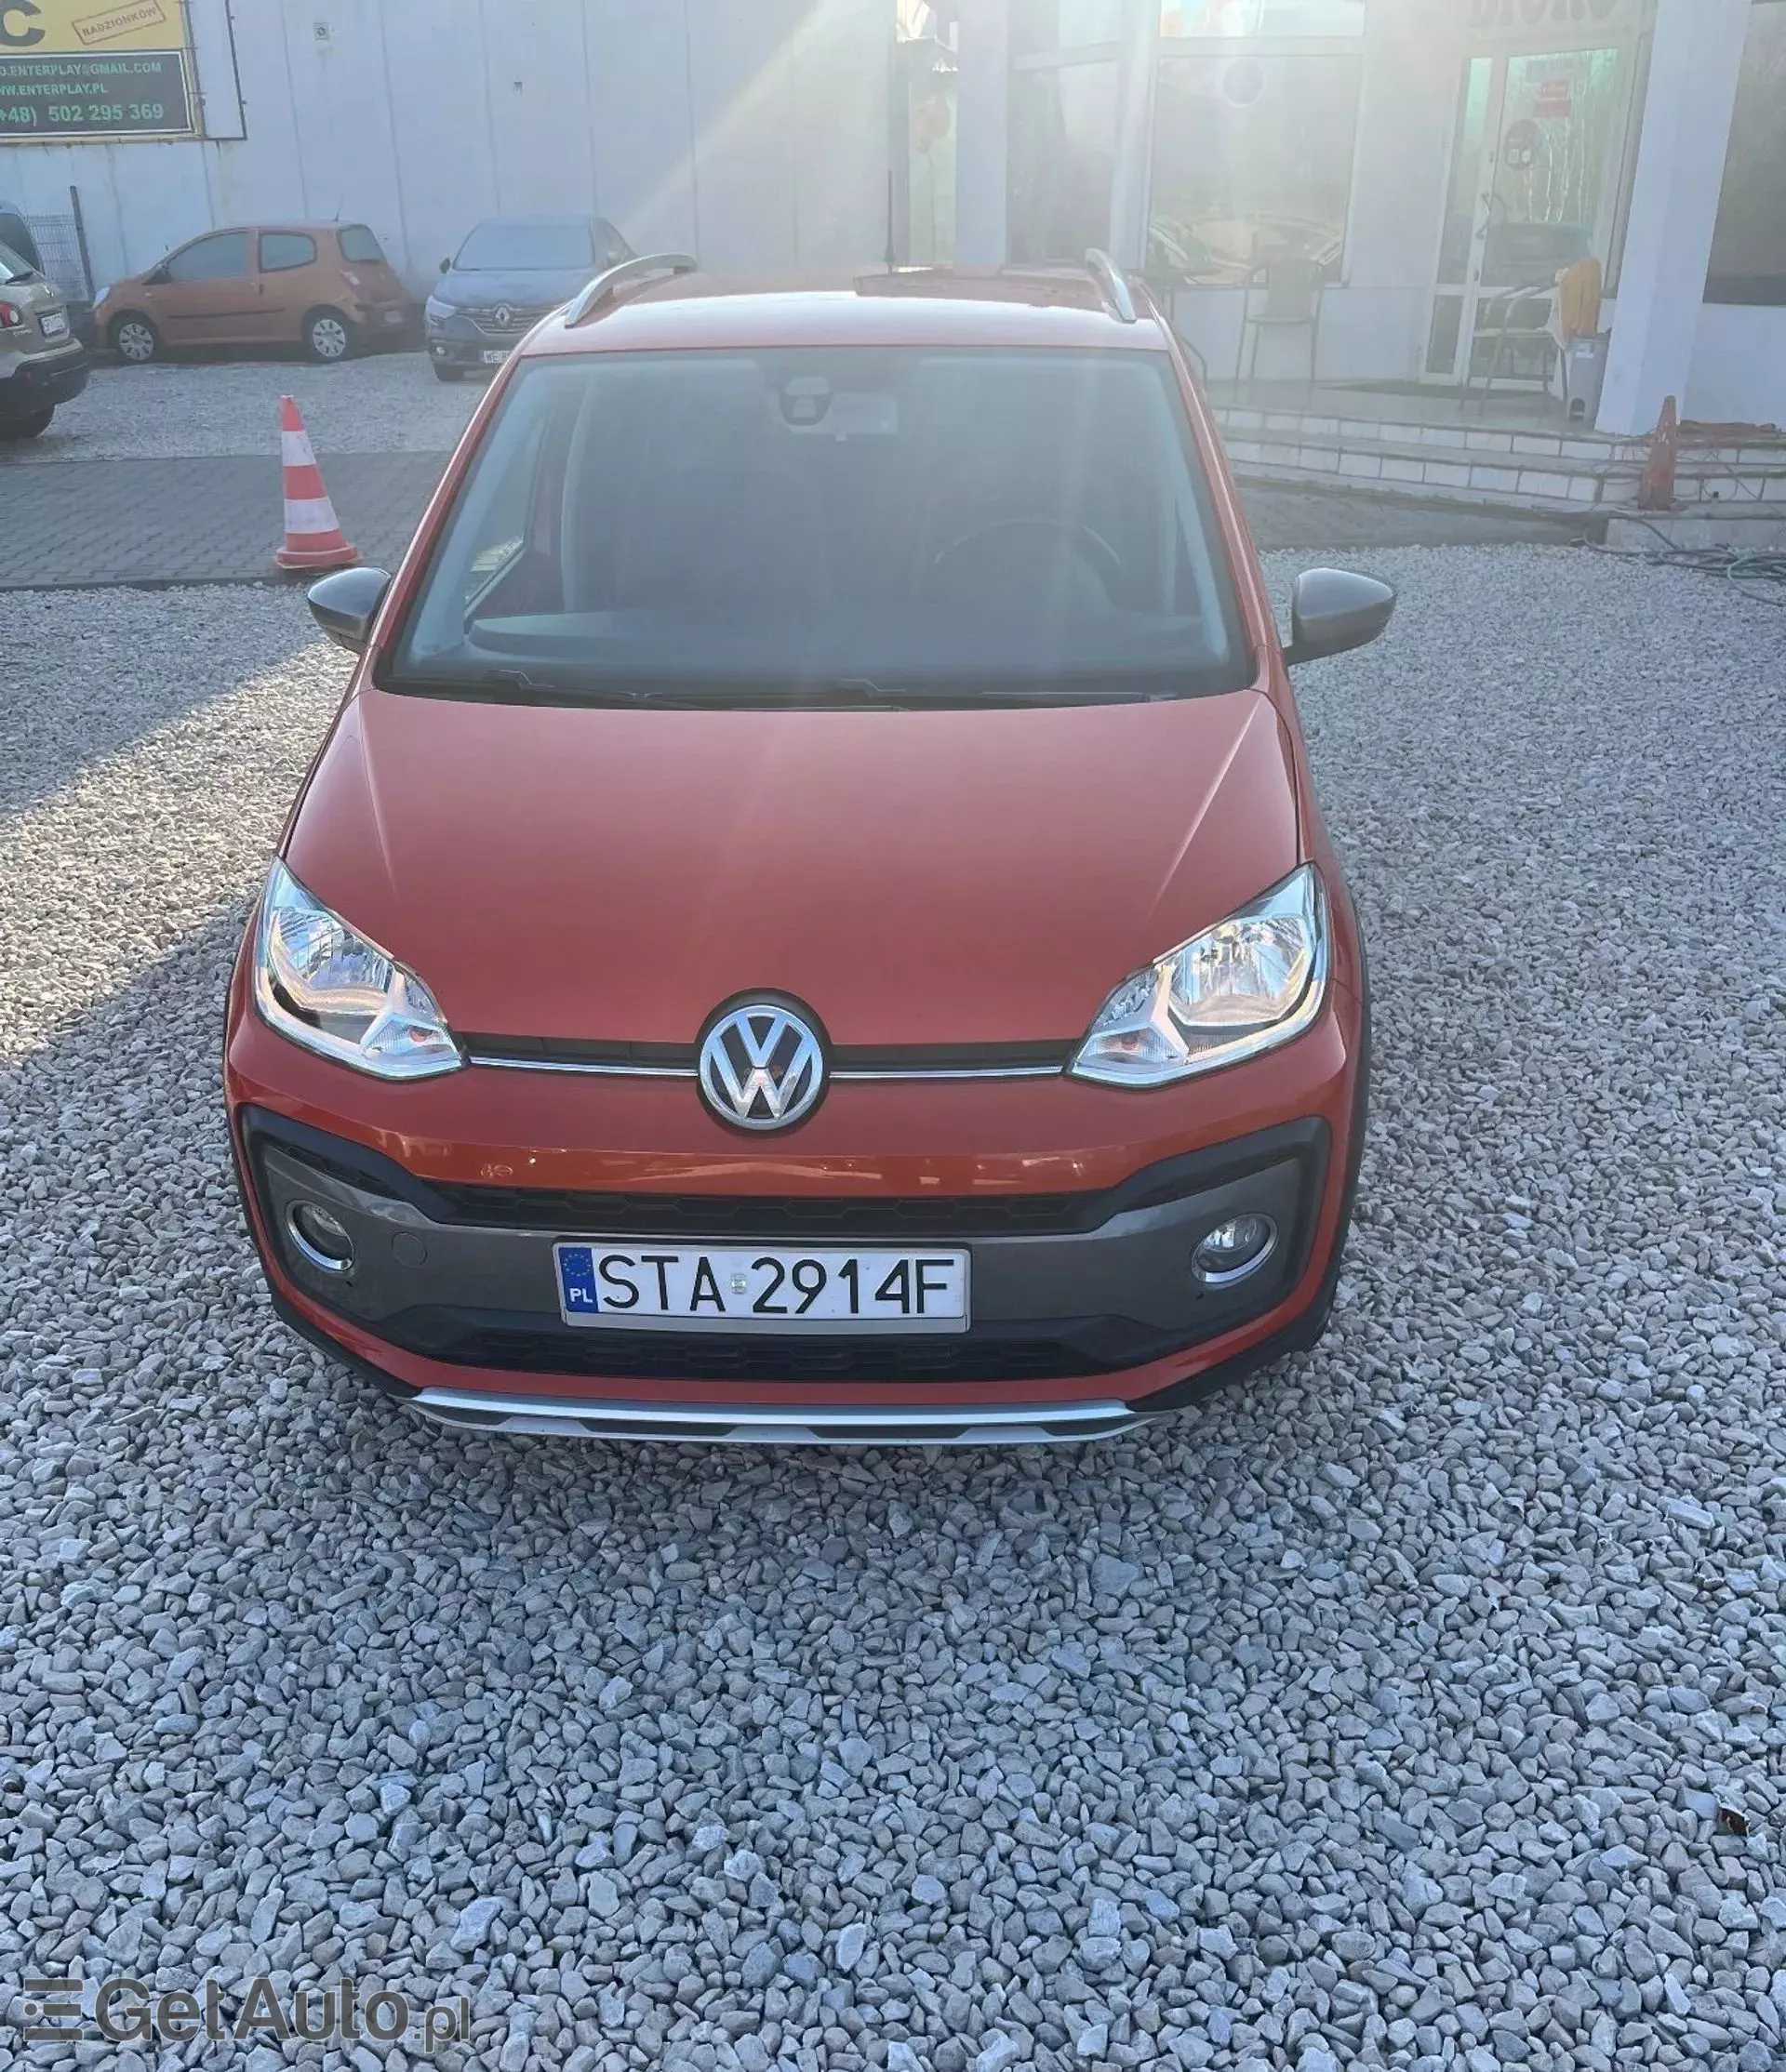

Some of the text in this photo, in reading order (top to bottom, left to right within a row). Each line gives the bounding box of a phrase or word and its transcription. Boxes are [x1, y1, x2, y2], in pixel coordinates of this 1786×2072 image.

[47, 104, 85, 123] 502
[88, 103, 124, 121] 295
[127, 102, 164, 120] 369
[598, 1254, 954, 1314] STA 2914F
[570, 1287, 593, 1303] PL
